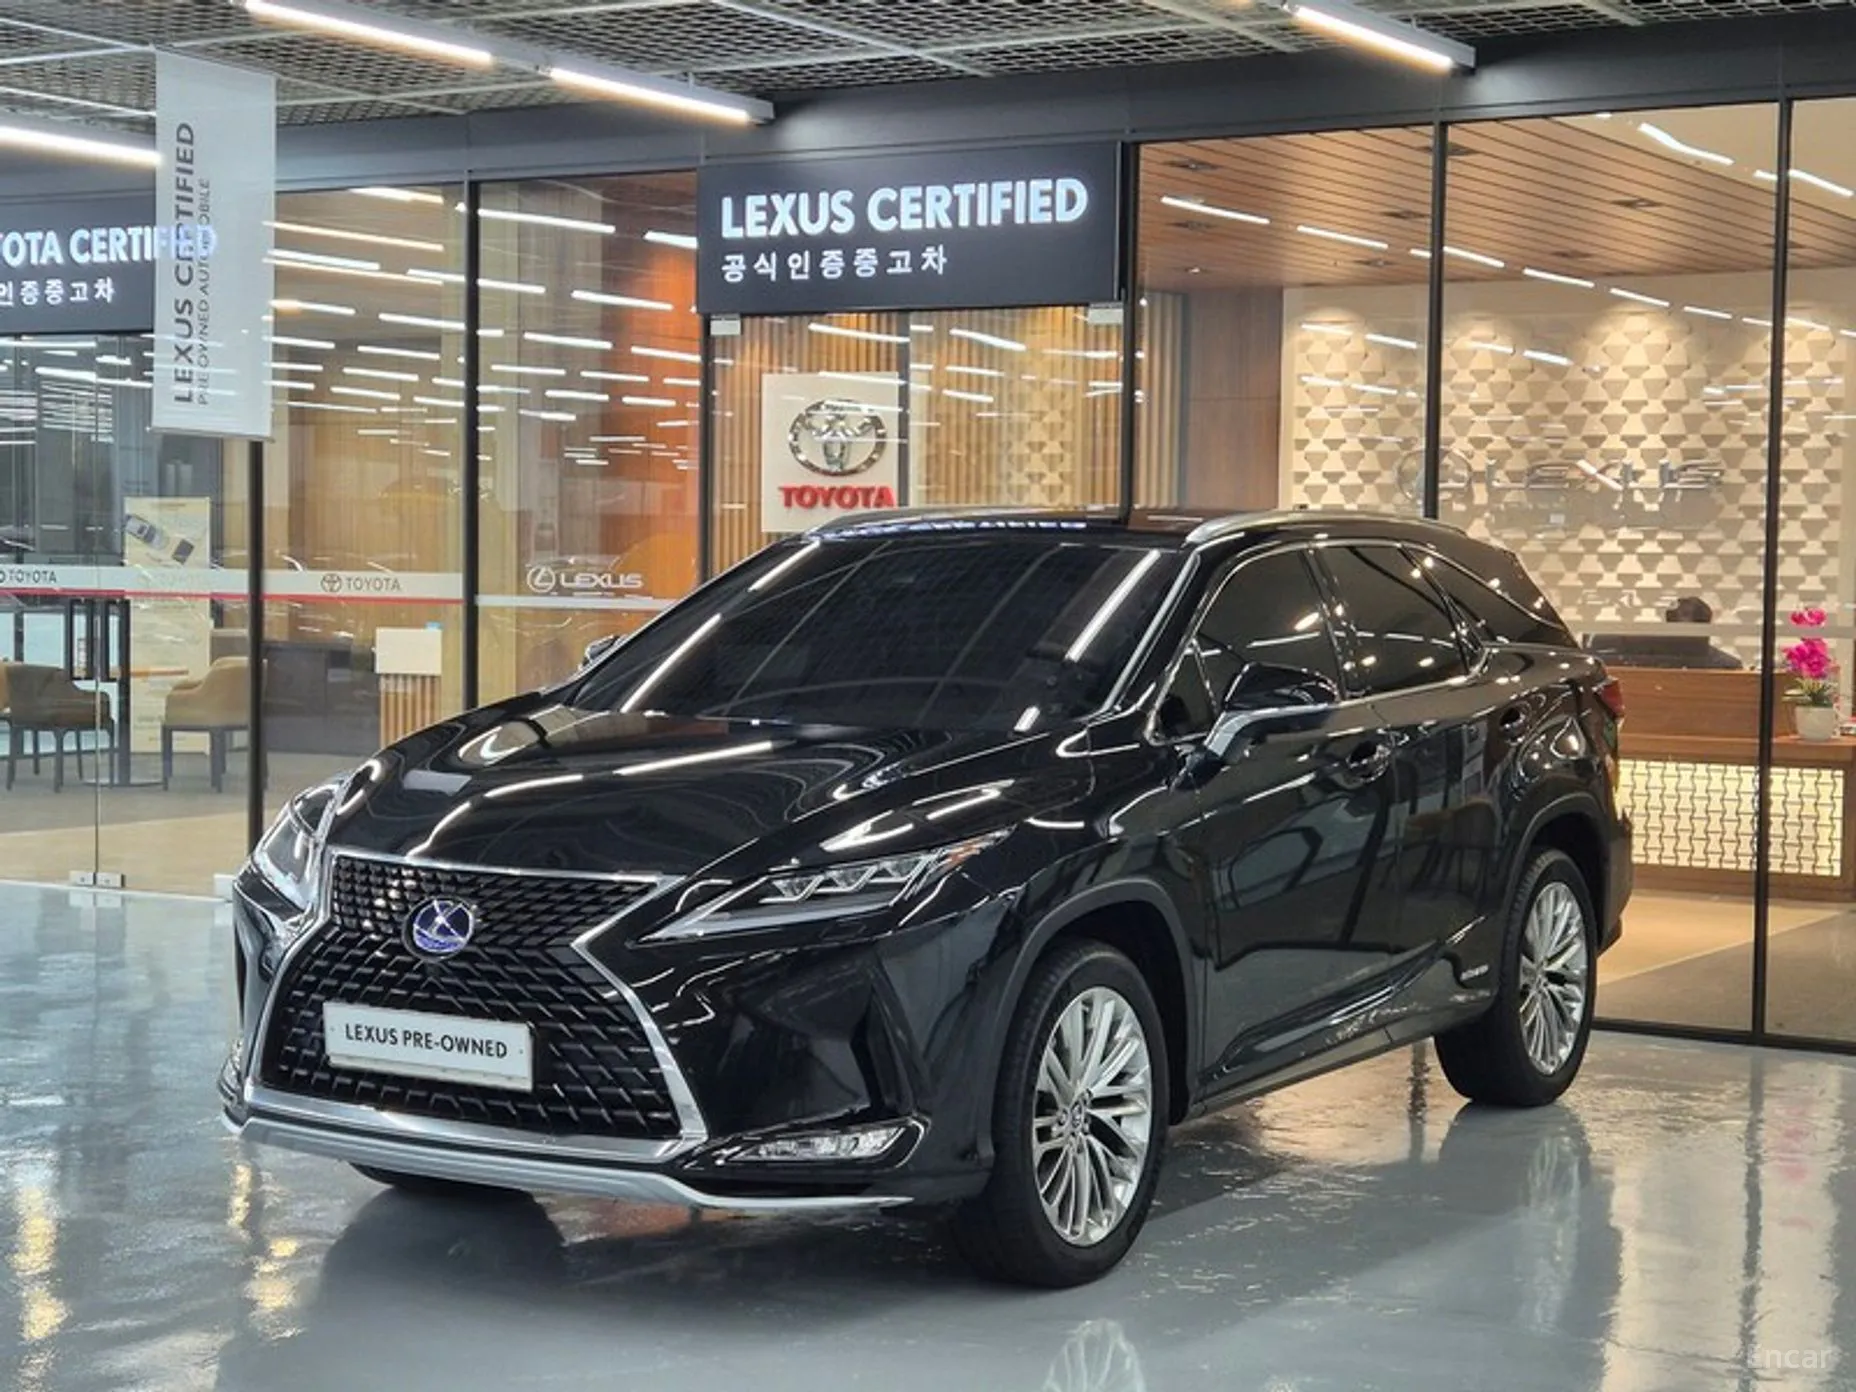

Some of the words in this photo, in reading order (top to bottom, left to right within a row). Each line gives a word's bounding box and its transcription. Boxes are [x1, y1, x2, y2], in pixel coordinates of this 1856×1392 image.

[721, 189, 855, 239] LEXUS
[867, 177, 1089, 232] CERTIFIED
[0, 230, 64, 267] OTA
[174, 298, 194, 403] LEXUS
[778, 484, 896, 509] TOYOTA
[8, 569, 57, 583] TOYOTA
[345, 576, 401, 592] TOYOTA
[560, 572, 644, 589] LEXUS
[345, 1022, 398, 1045] LEXUS
[403, 1029, 508, 1059] PRE-OWNED
